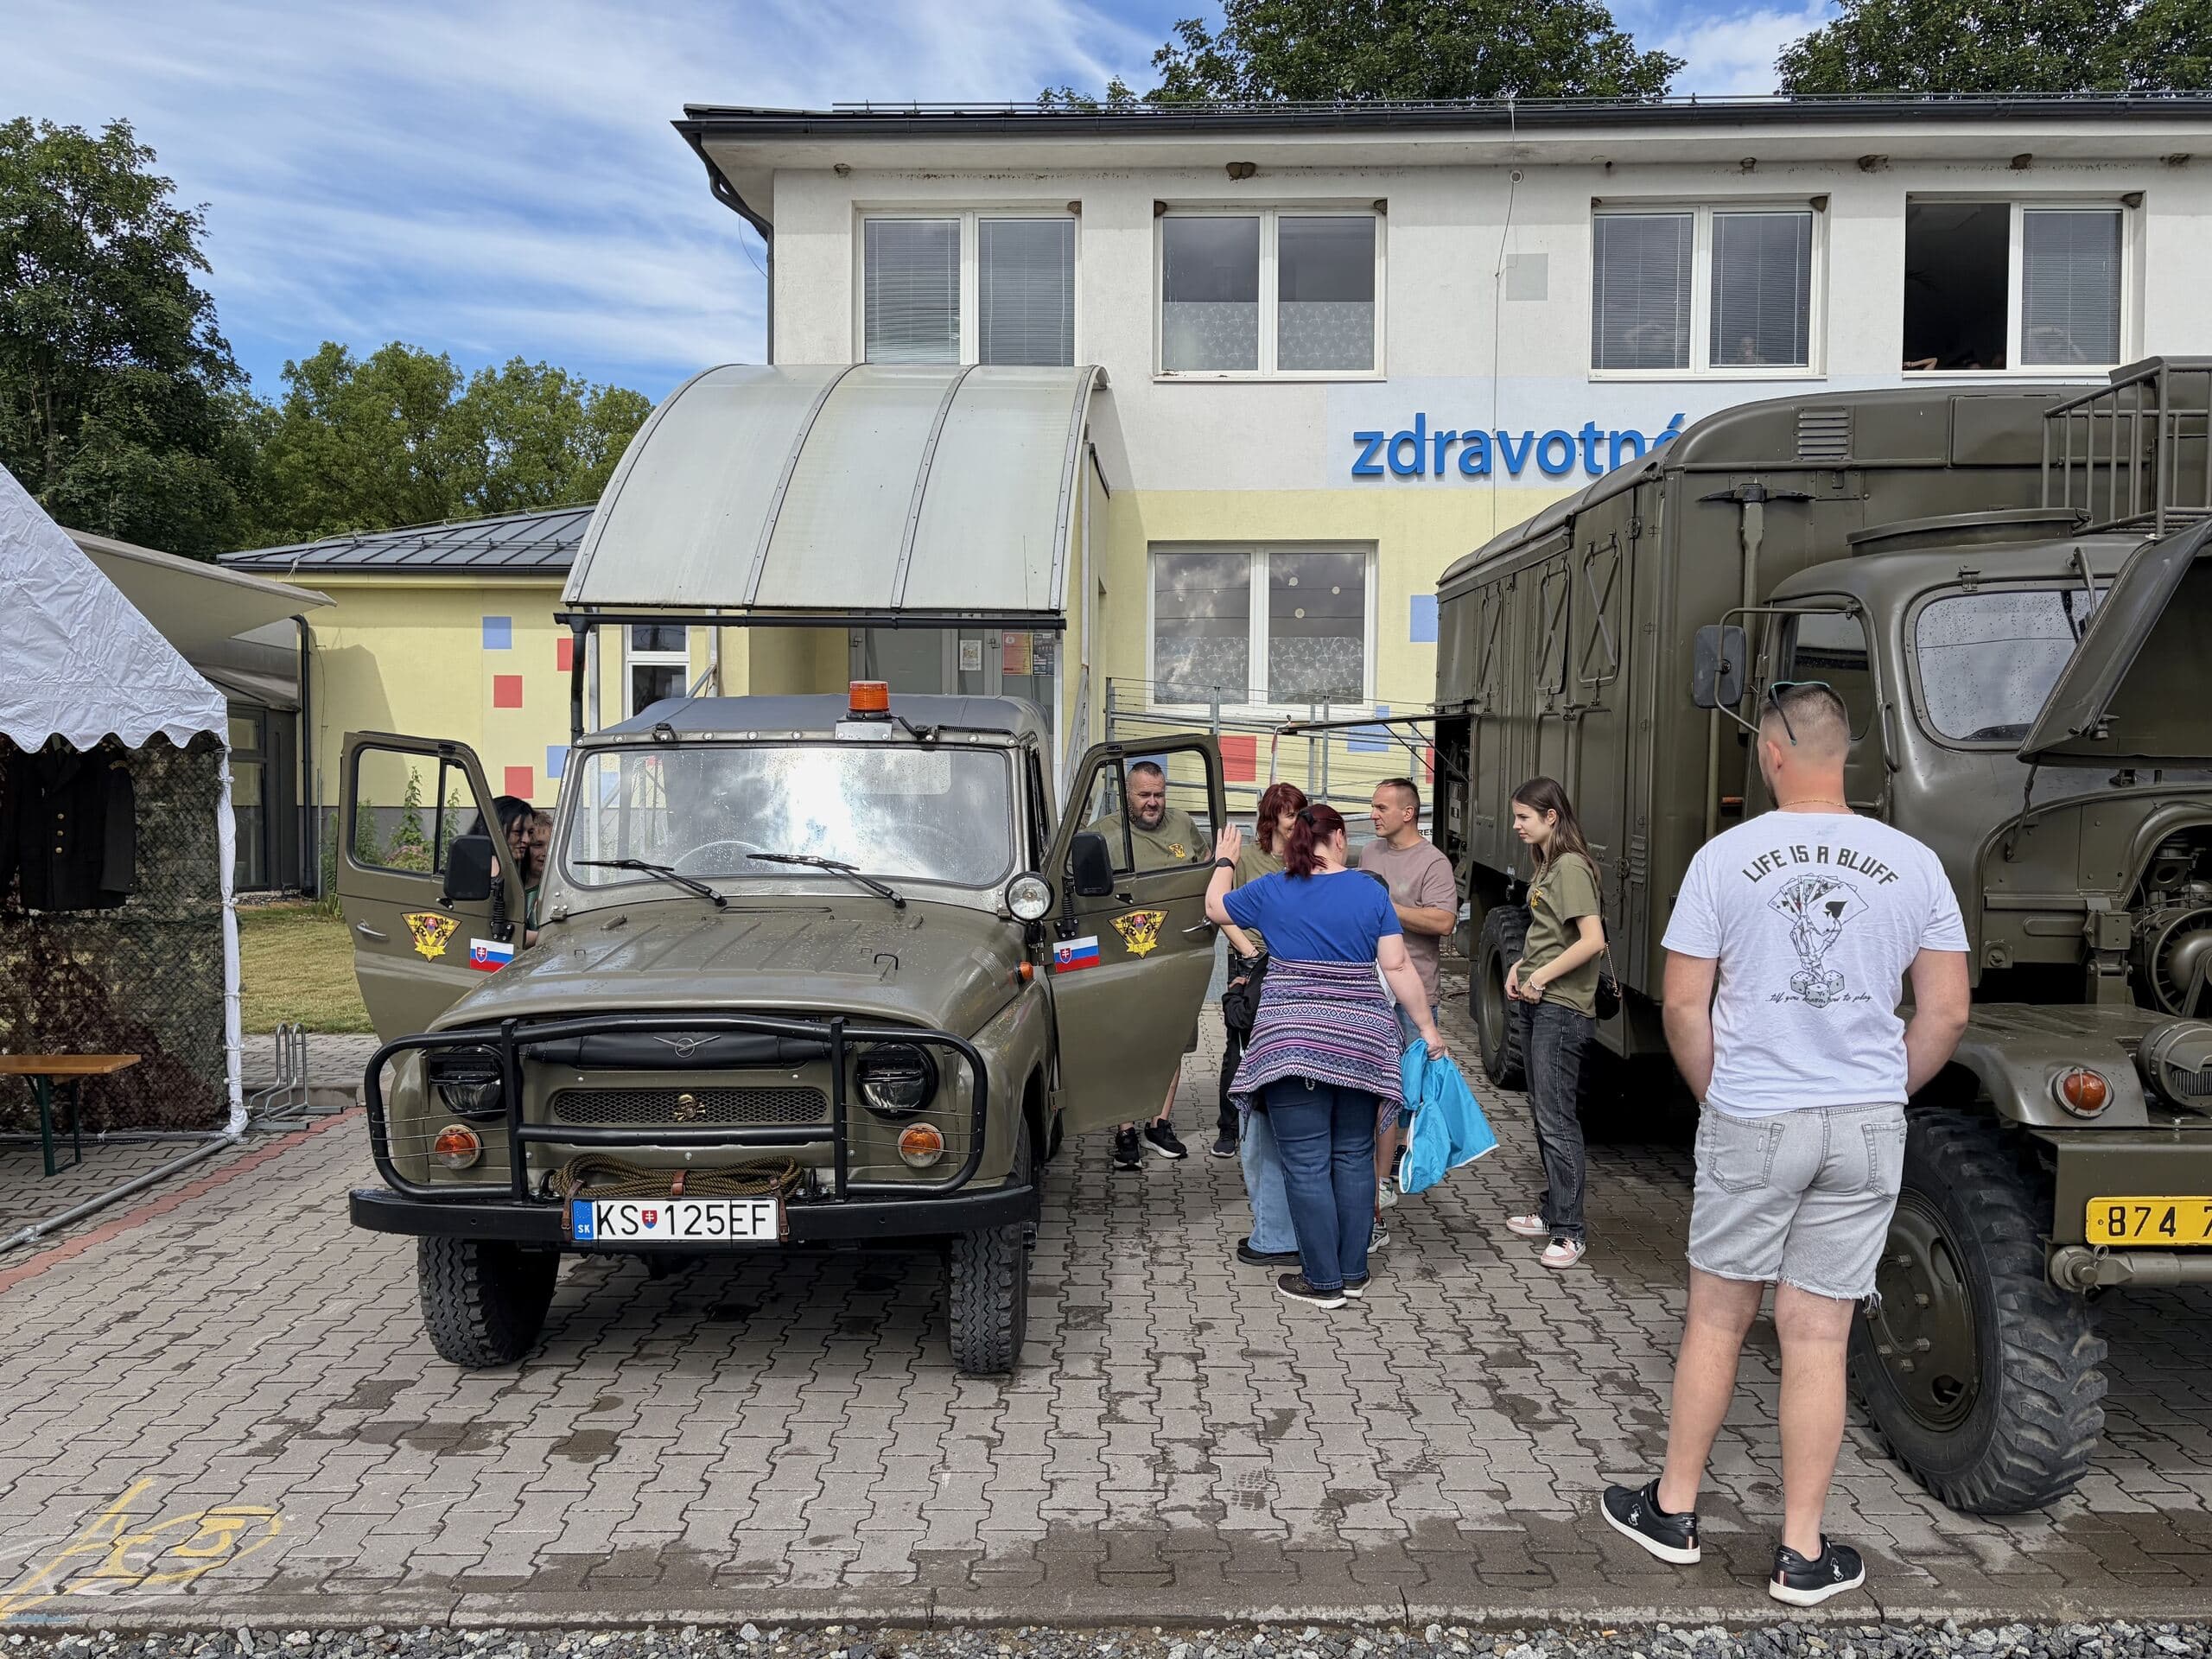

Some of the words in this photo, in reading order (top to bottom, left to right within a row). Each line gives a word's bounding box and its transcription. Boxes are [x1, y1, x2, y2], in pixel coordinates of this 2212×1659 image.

[1742, 849, 1788, 883] LIFE
[1789, 845, 1810, 863] IS
[1816, 846, 1829, 864] A
[1836, 848, 1899, 885] BLUFF
[578, 1224, 590, 1233] SK
[598, 1205, 639, 1236] KS
[664, 1205, 770, 1236] 125EF
[2108, 1206, 2177, 1237] 874
